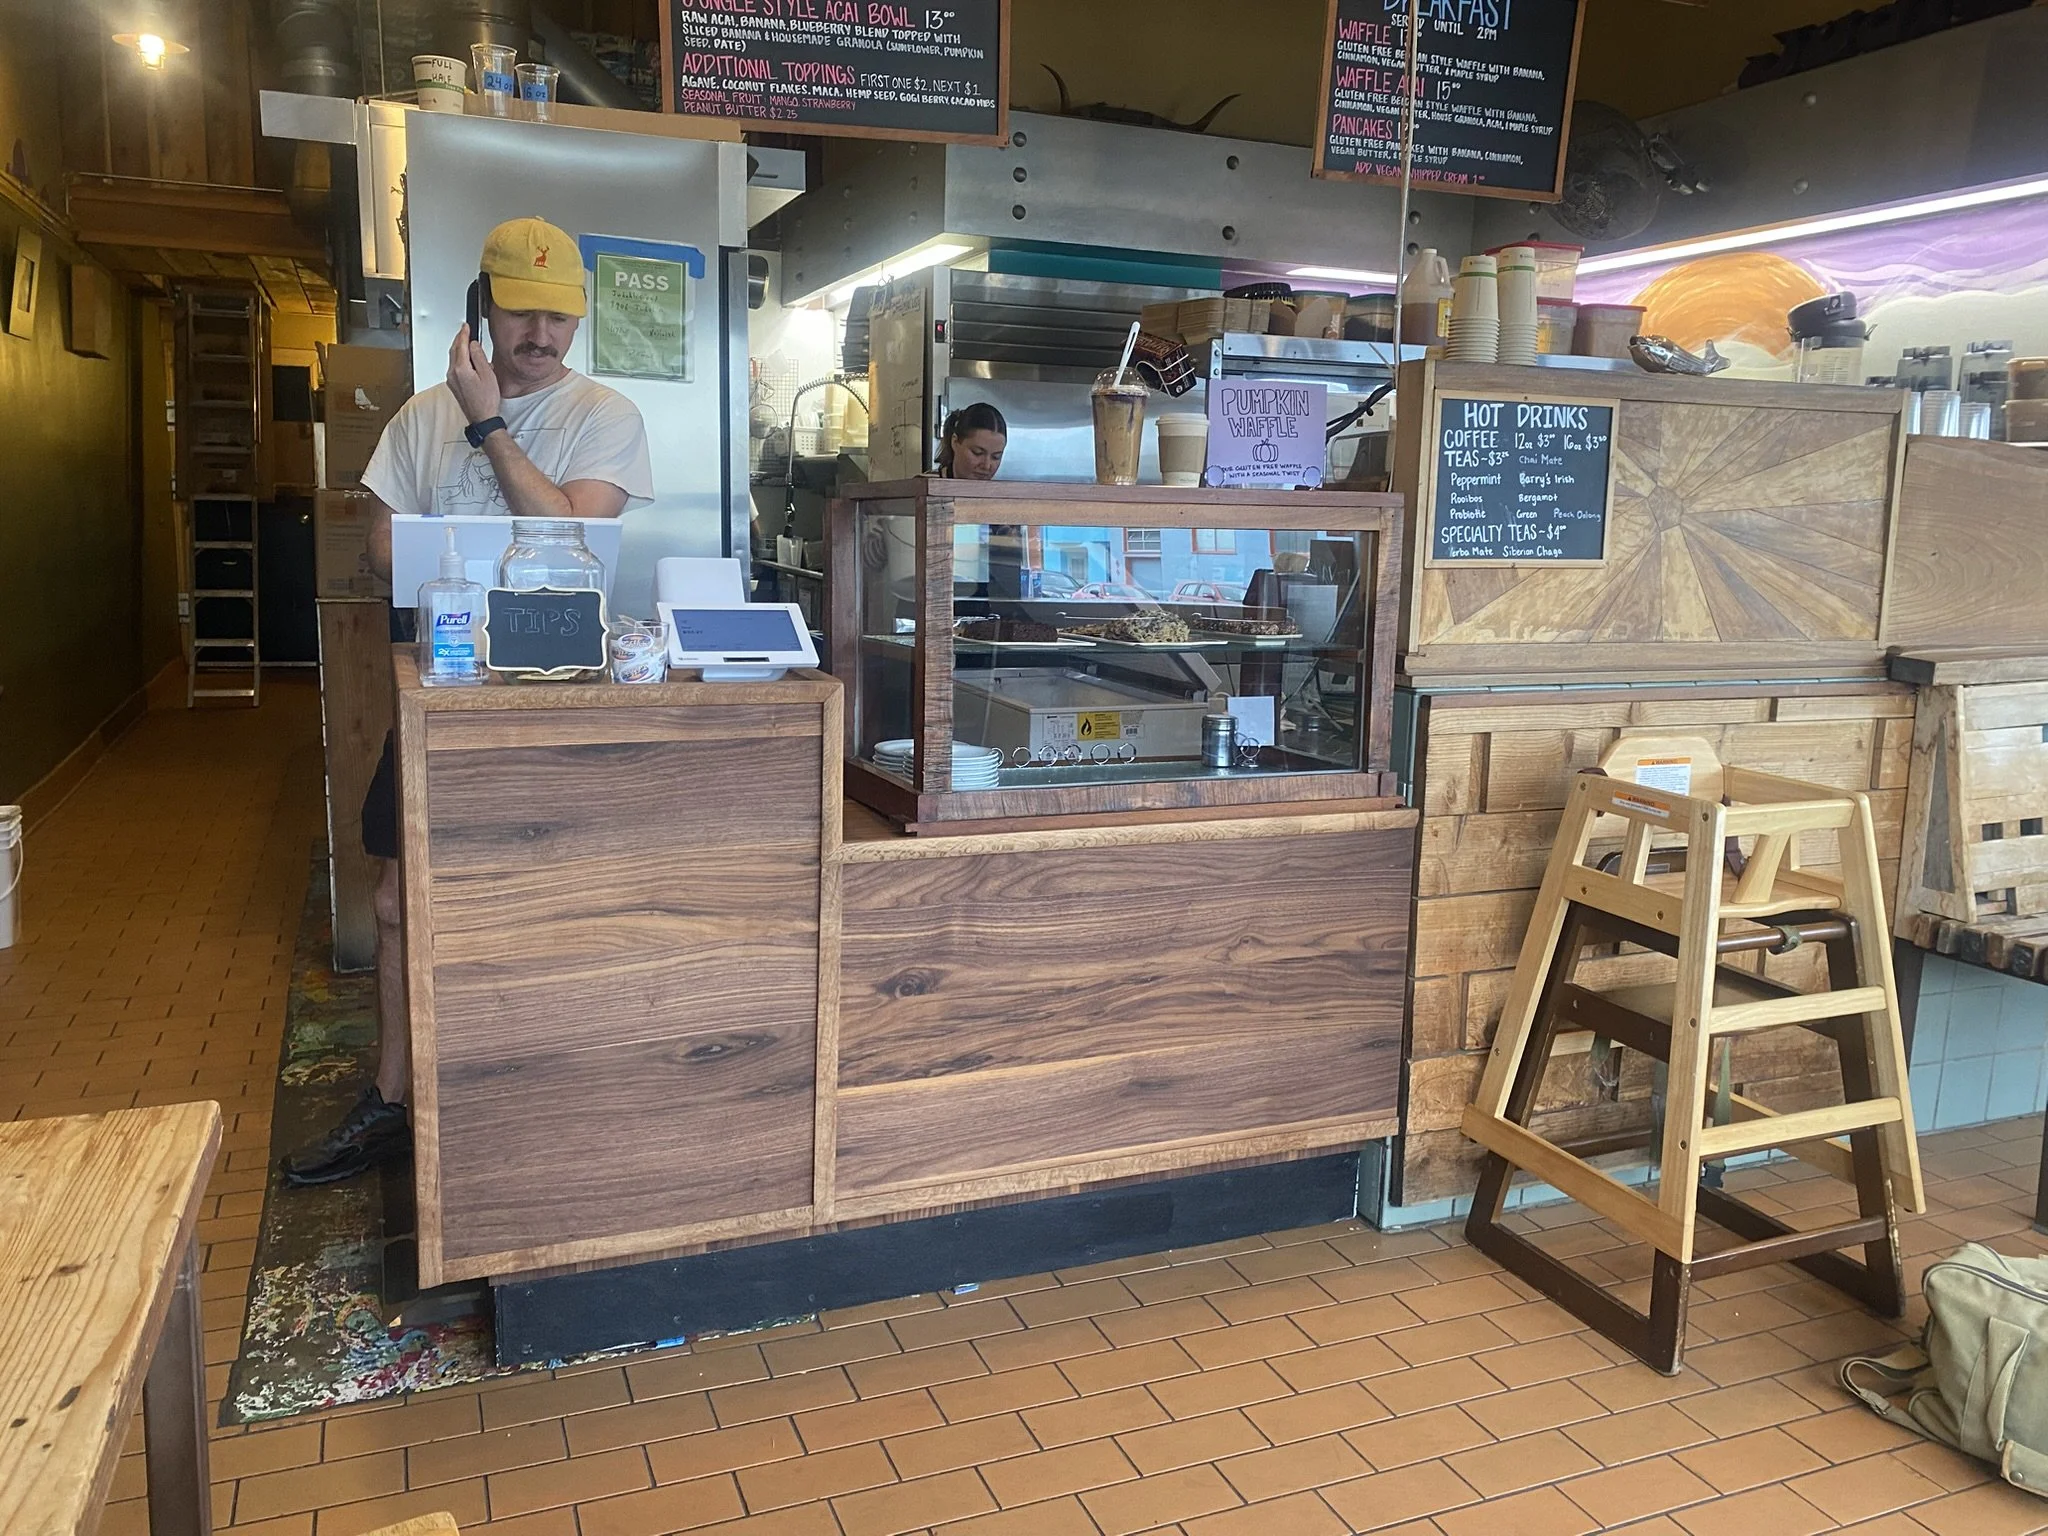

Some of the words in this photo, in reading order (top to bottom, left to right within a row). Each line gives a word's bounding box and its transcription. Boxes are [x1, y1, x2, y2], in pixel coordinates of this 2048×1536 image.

[825, 0, 859, 22] ACAI
[868, 3, 915, 28] BOWL
[681, 10, 708, 24] RAW
[790, 20, 851, 35] BLUEBERRY
[855, 25, 889, 38] BLEND
[892, 29, 931, 42] TOPPED
[934, 33, 961, 44] WITH
[1339, 18, 1391, 45] WAFFLE
[1434, 20, 1464, 35] UNTIL
[1476, 27, 1497, 40] 2PM
[682, 23, 718, 36] SLICED
[721, 28, 761, 41] BANANA
[772, 31, 831, 46] HOUSEMADE
[836, 36, 883, 50] GRANOLA
[944, 46, 984, 60] PUMPKIN
[714, 38, 746, 52] DATE)
[431, 59, 453, 70] FULL
[1337, 40, 1369, 54] GLUTEN
[1371, 45, 1392, 57] FREE
[1431, 54, 1453, 66] STYLE
[1456, 58, 1486, 72] WAFFLE
[1488, 64, 1510, 75] WITH
[432, 73, 452, 84] HALF
[487, 75, 502, 88] 24
[682, 52, 778, 80] ADDITIONAL
[782, 62, 855, 85] TOPPINGS
[860, 73, 890, 89] FIRST
[892, 77, 911, 89] ONE
[933, 80, 961, 93] NEXT
[964, 81, 981, 96] $1
[1336, 65, 1392, 93] WAFFLE
[1450, 69, 1474, 80] MAPLE
[1476, 73, 1500, 83] SYRUP
[535, 91, 547, 99] oz
[682, 88, 729, 103] SEASONAL
[732, 92, 762, 105] FRUIT
[802, 98, 856, 111] STRAWBERRY
[722, 79, 766, 92] COCONUT
[845, 88, 871, 99] HEMP
[899, 92, 920, 103] GOGI
[976, 98, 996, 109] NIBS
[1334, 88, 1365, 101] GLUTEN
[1367, 92, 1389, 104] FREE
[1426, 100, 1449, 112] STYLE
[1451, 103, 1482, 116] WAFFLE
[1484, 107, 1505, 119] WITH
[683, 101, 721, 114] PEANUT
[725, 103, 767, 118] BUTTER
[1332, 113, 1393, 139] PANCAKES
[1376, 105, 1400, 116] VEGAN
[1431, 111, 1453, 122] HOUSE
[1530, 125, 1554, 136] SYRUP
[1329, 134, 1361, 147] GLUTEN
[1363, 138, 1384, 149] FREE
[1428, 145, 1449, 156] WITH
[1331, 146, 1355, 155] VEGAN
[1424, 155, 1448, 165] SYRUP
[1354, 161, 1372, 174] ADD
[1443, 171, 1468, 185] CREAM
[615, 272, 669, 291] PASS
[1221, 388, 1310, 416] PUMPKIN
[1464, 402, 1505, 428] HOT
[1517, 404, 1589, 430] DRINKS
[1228, 416, 1298, 438] WAFFLE
[1444, 429, 1499, 449] COFFEE
[1443, 449, 1479, 468] TEAS
[1519, 453, 1538, 464] Chai
[1541, 453, 1563, 465] Mate
[1451, 472, 1501, 491] Peppermint
[1519, 472, 1551, 488] Barry's
[1554, 474, 1575, 484] Irish
[1450, 492, 1483, 504] Rooibos
[1518, 493, 1558, 506] Bergamot
[1450, 508, 1487, 520] Probiotic
[1516, 509, 1538, 519] Green
[1553, 507, 1575, 518] Peach
[1441, 524, 1503, 544] SPECIALTY
[1508, 523, 1537, 542] TEAS
[1472, 546, 1494, 556] Mate
[1502, 545, 1535, 558] Siberian
[1536, 545, 1563, 558] Chaga
[440, 614, 468, 625] Purell
[503, 607, 582, 637] TIPS
